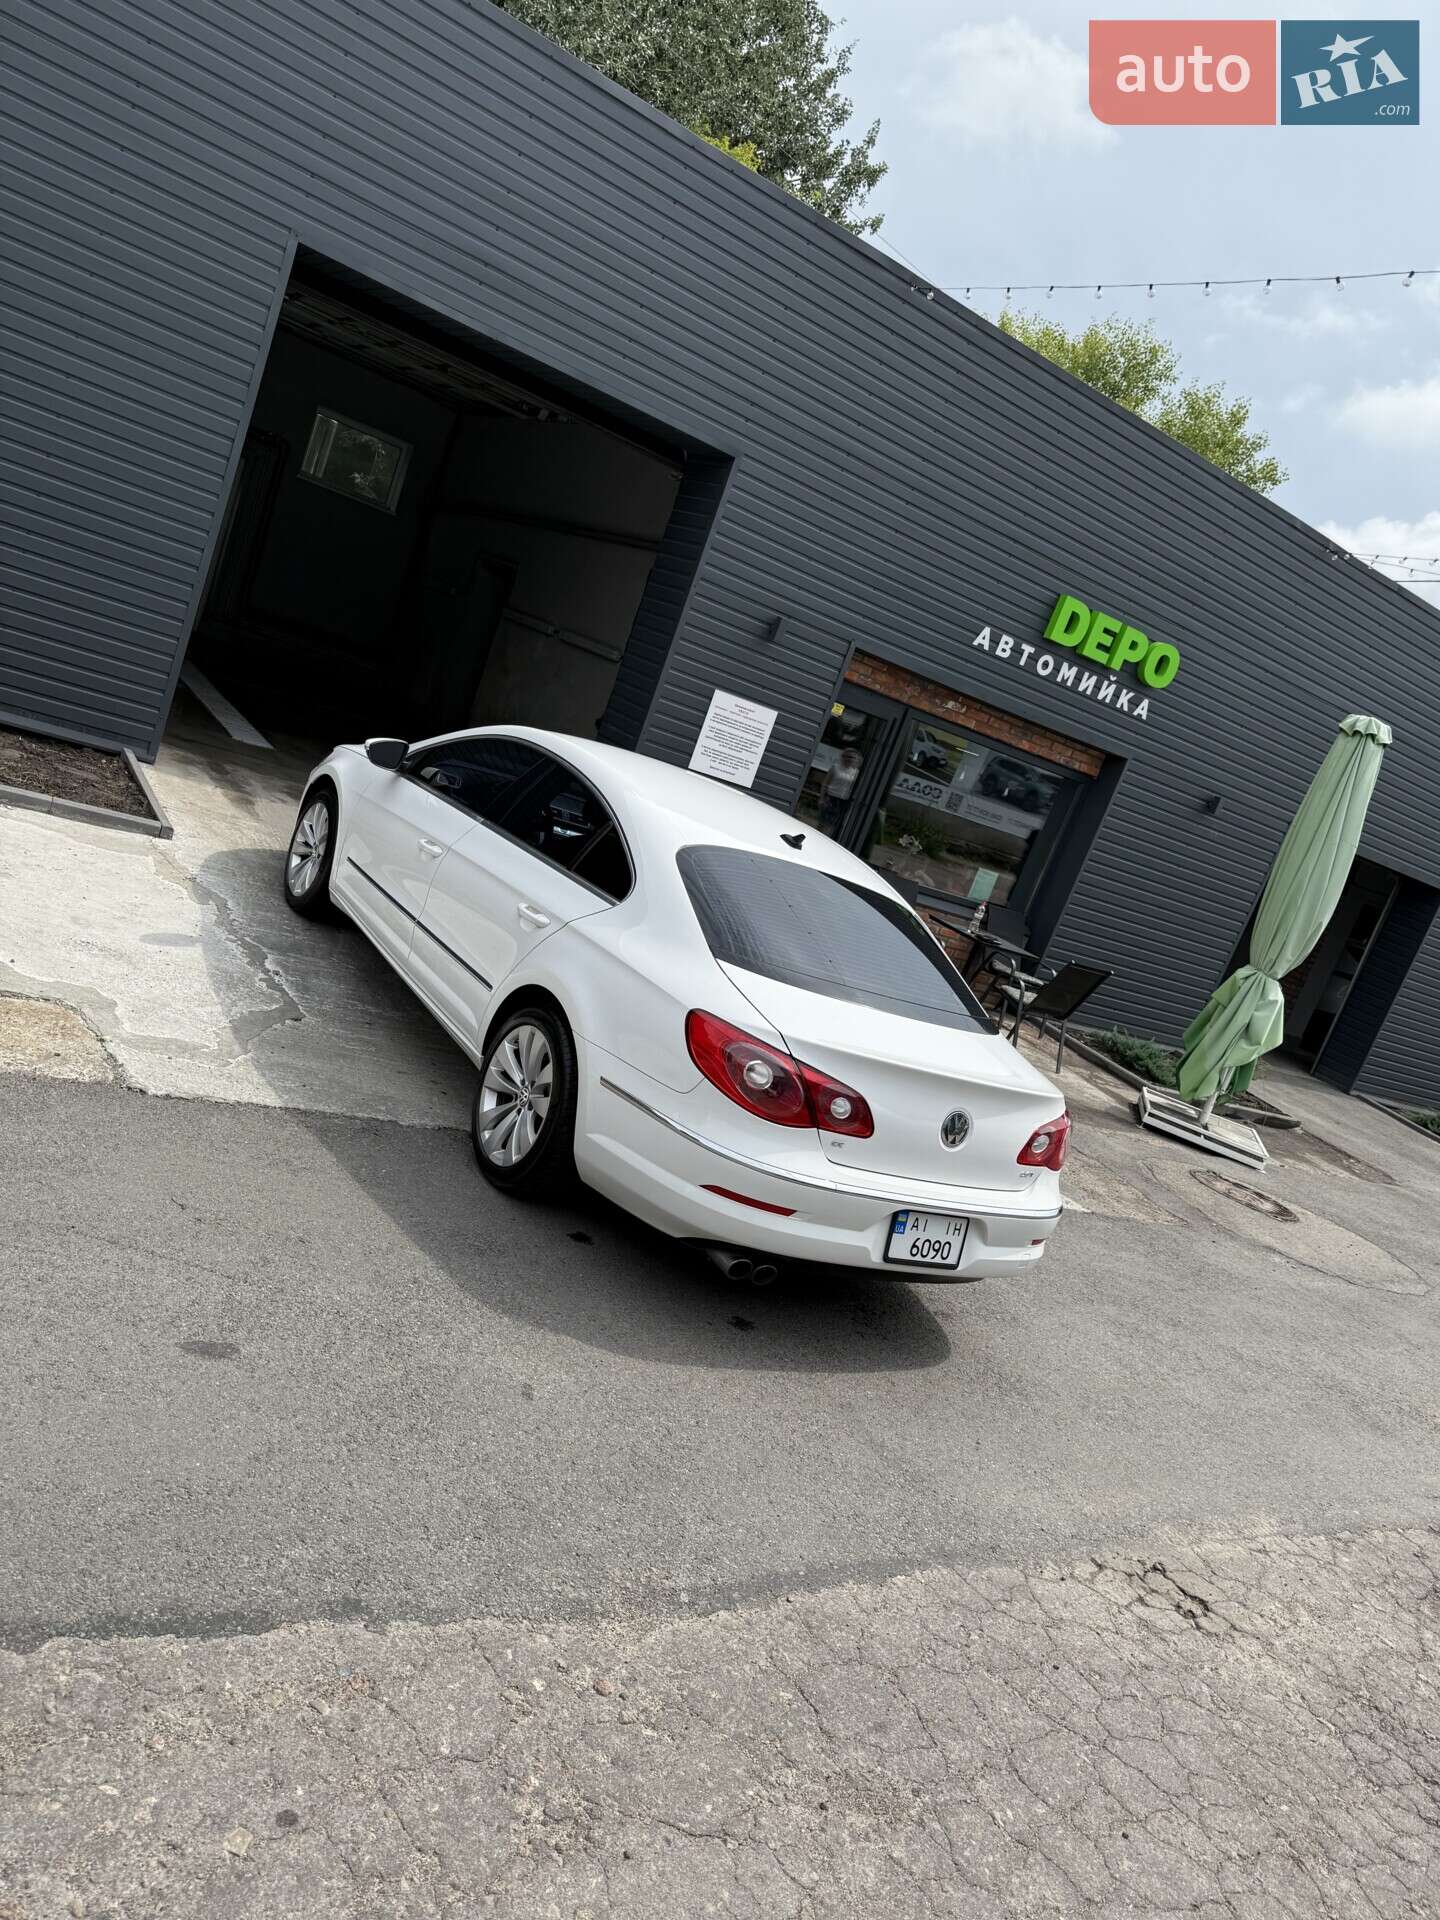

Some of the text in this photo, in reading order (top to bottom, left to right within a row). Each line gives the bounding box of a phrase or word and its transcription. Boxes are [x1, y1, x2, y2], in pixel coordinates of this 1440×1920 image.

[972, 626, 1150, 720] АВТОМИЙКА
[1043, 593, 1181, 689] DEPO
[909, 1237, 952, 1260] 6090
